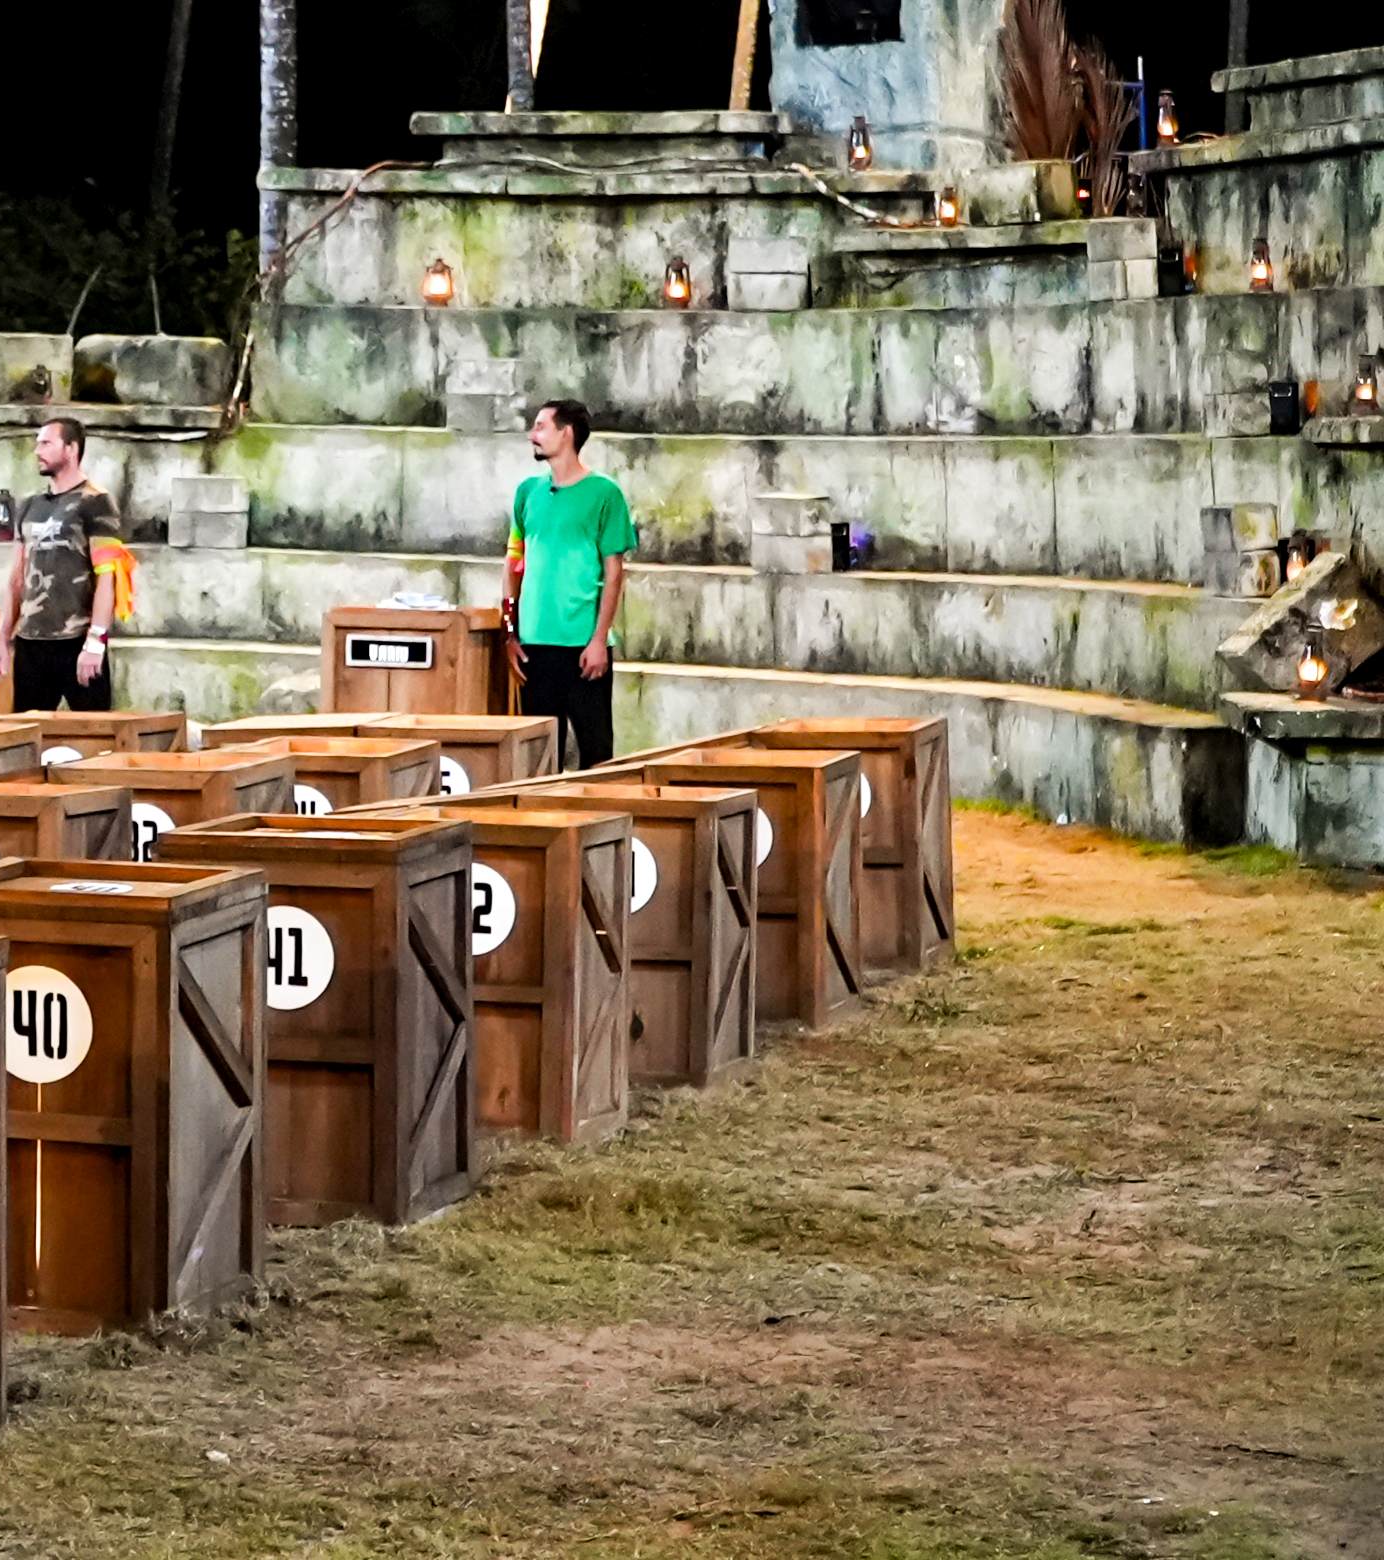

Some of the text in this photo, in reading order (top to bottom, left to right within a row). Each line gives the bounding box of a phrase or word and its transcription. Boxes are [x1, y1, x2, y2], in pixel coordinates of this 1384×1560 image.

[472, 882, 493, 934] 2
[267, 927, 308, 987] 41
[13, 990, 68, 1060] 40
